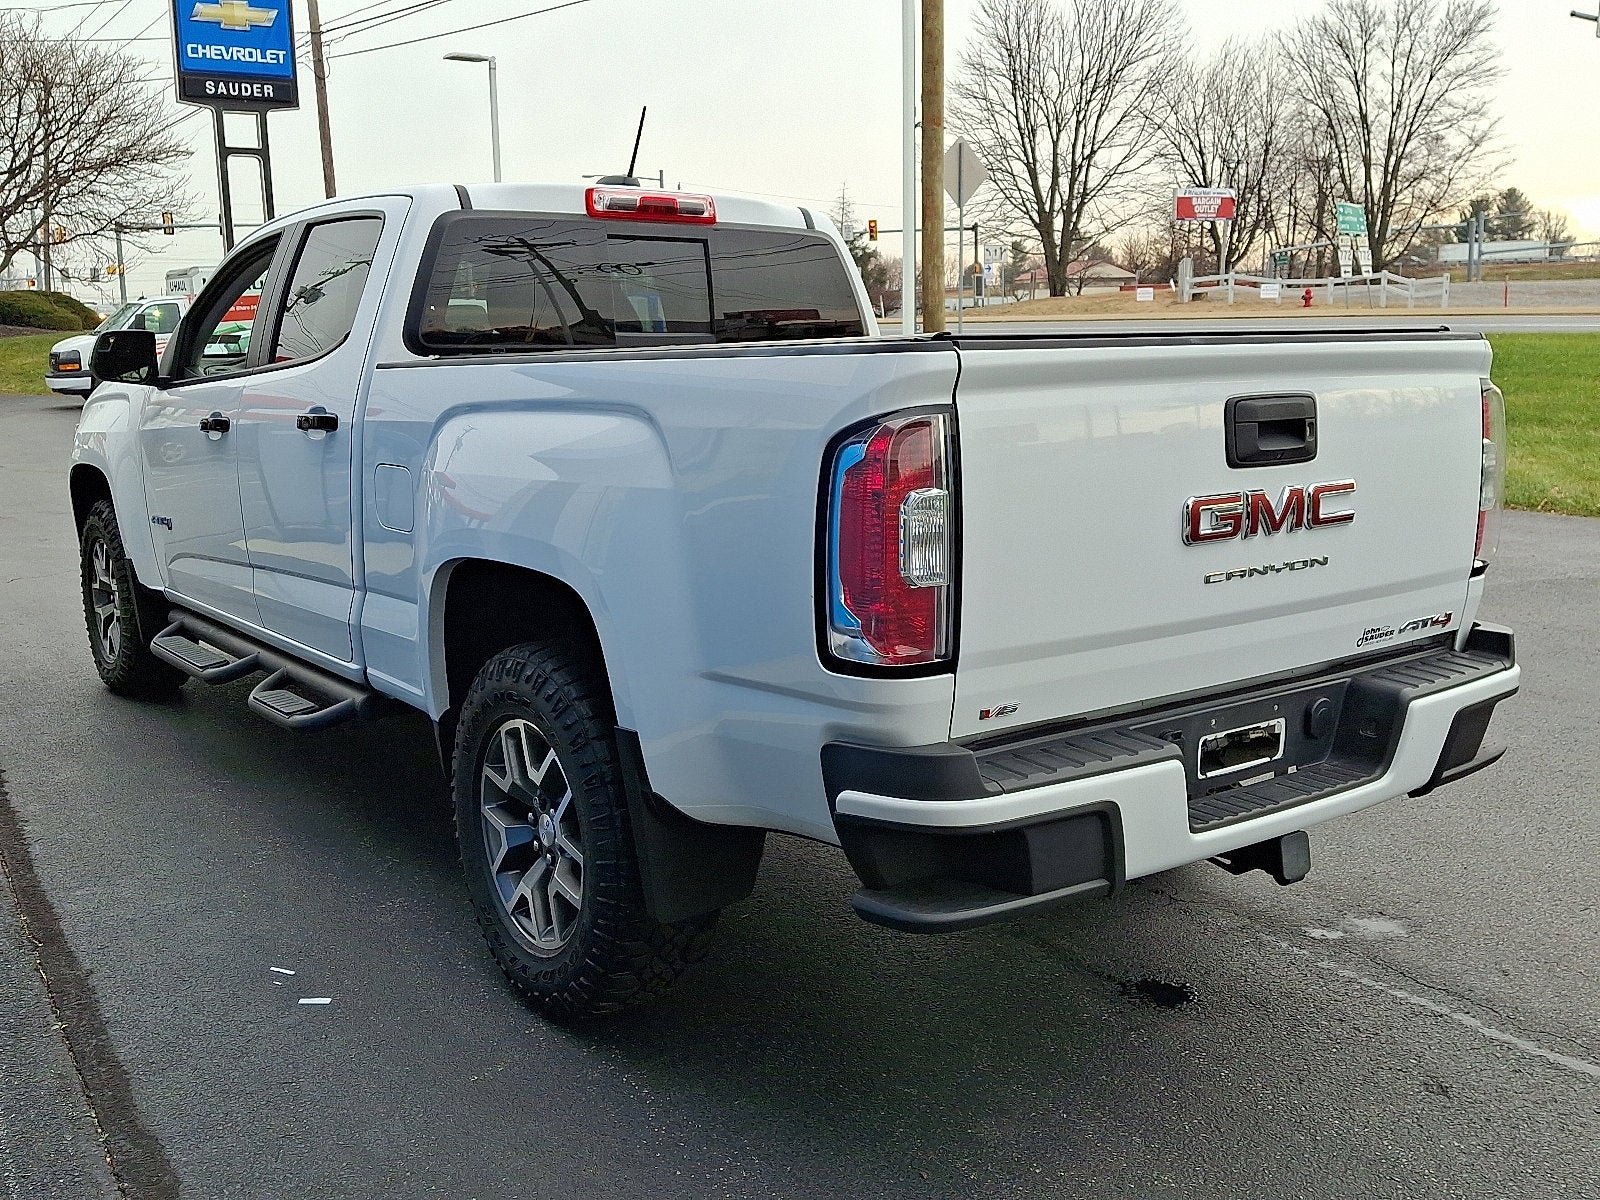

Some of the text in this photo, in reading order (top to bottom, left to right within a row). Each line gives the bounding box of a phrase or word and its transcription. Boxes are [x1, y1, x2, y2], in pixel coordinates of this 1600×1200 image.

[186, 43, 286, 64] CHEVROLET
[205, 80, 274, 98] SAUDER
[1192, 197, 1222, 205] BARGAIN
[1194, 205, 1218, 213] OUTLET
[1182, 478, 1357, 547] GMC
[1204, 555, 1329, 585] CANYON
[1364, 629, 1396, 643] SAUDER
